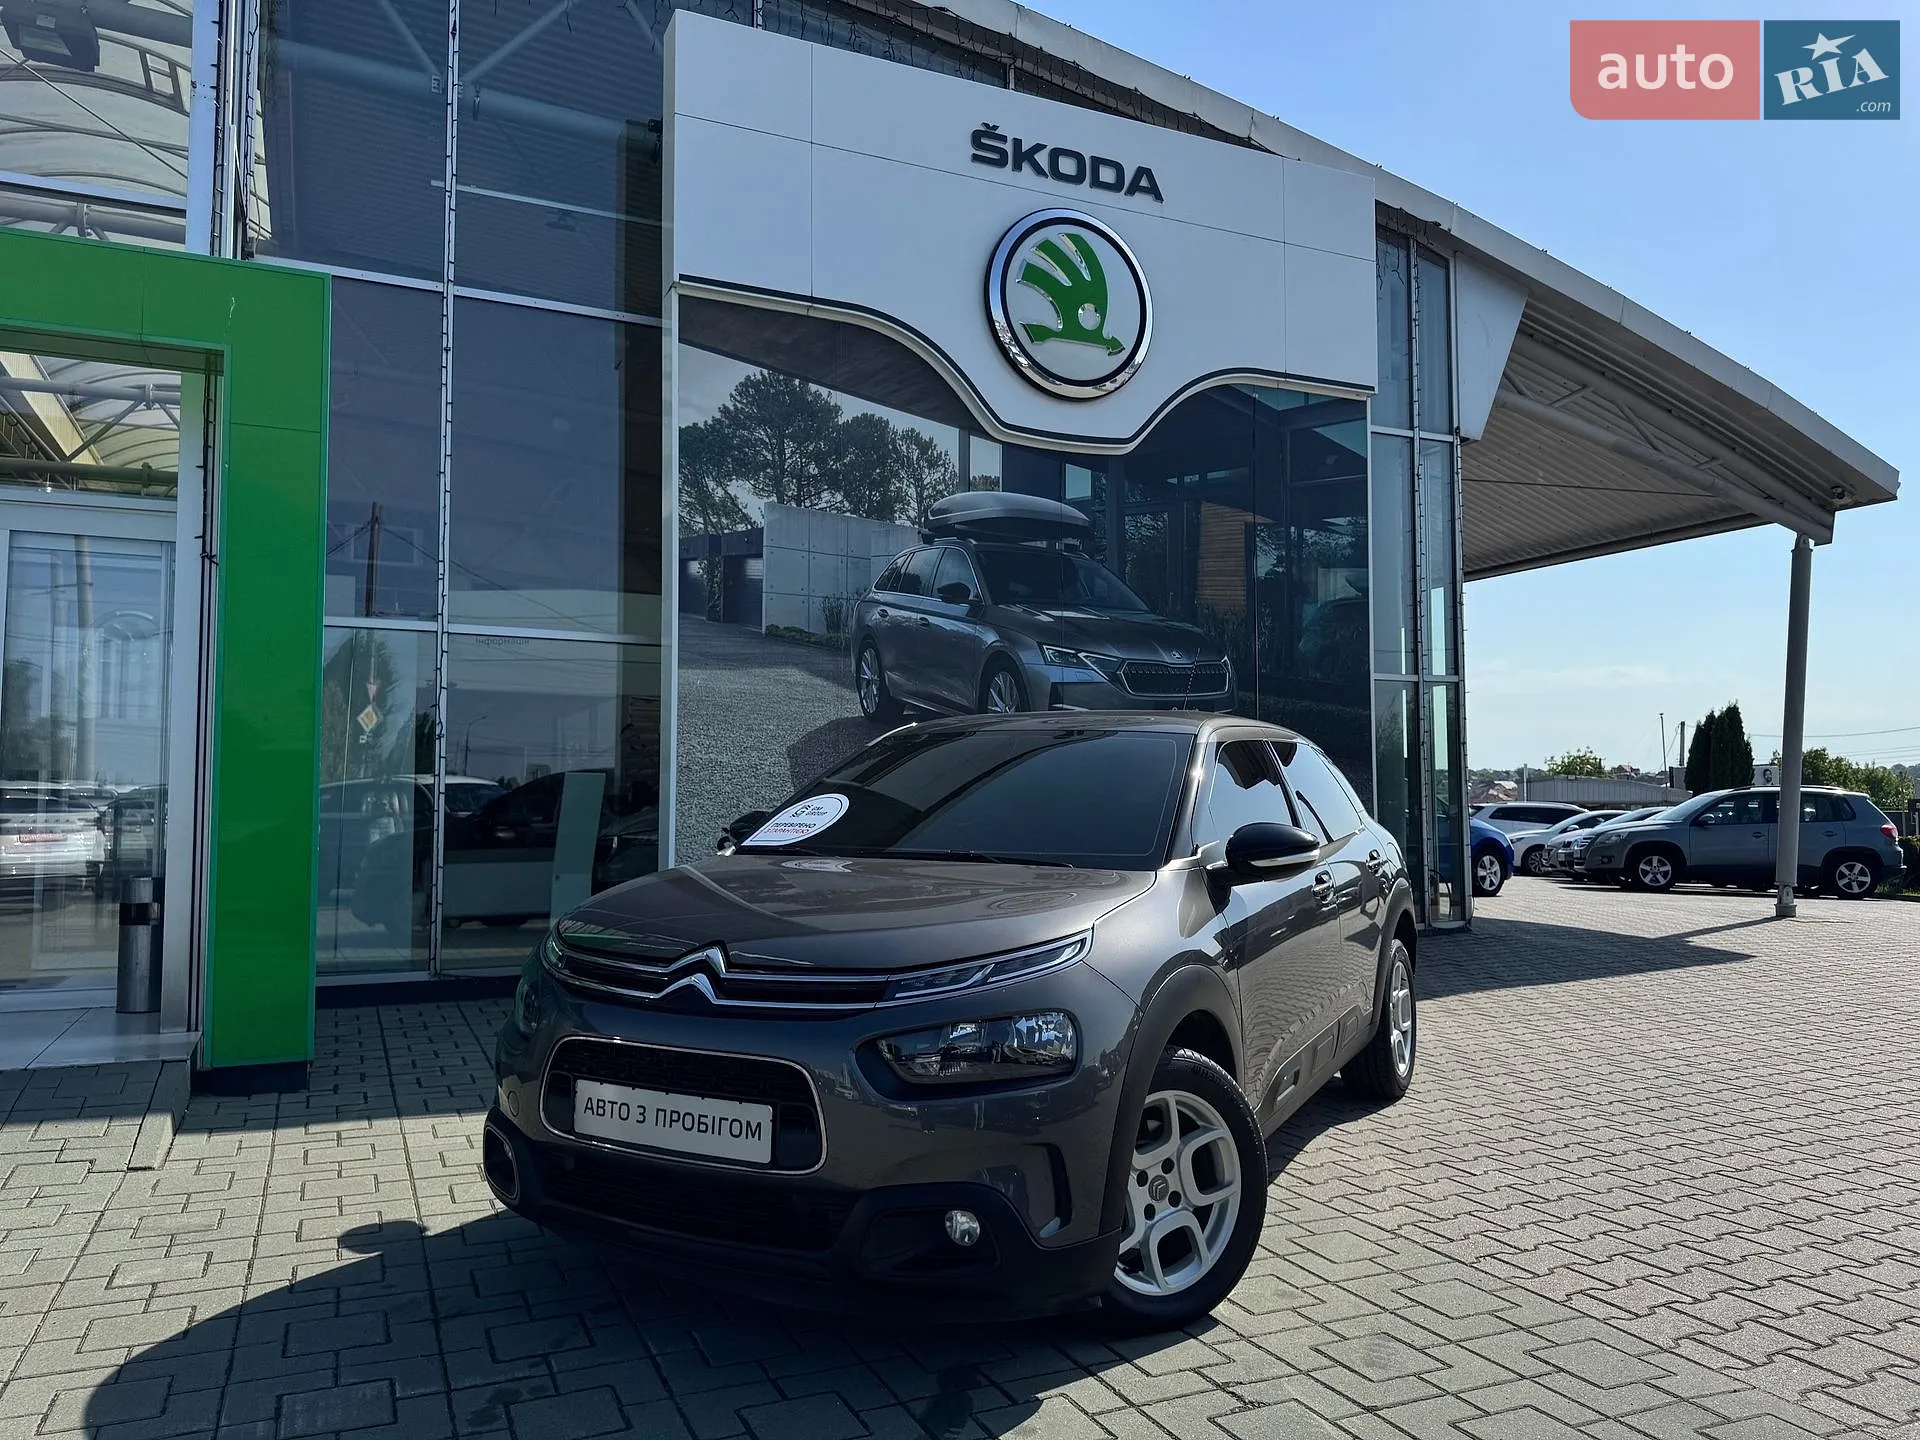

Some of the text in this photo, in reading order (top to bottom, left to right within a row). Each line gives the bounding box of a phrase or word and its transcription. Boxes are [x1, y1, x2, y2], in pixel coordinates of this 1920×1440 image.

[970, 122, 1165, 204] ŠKODA
[583, 1096, 762, 1141] АВТО З ПРОБІГОМ
